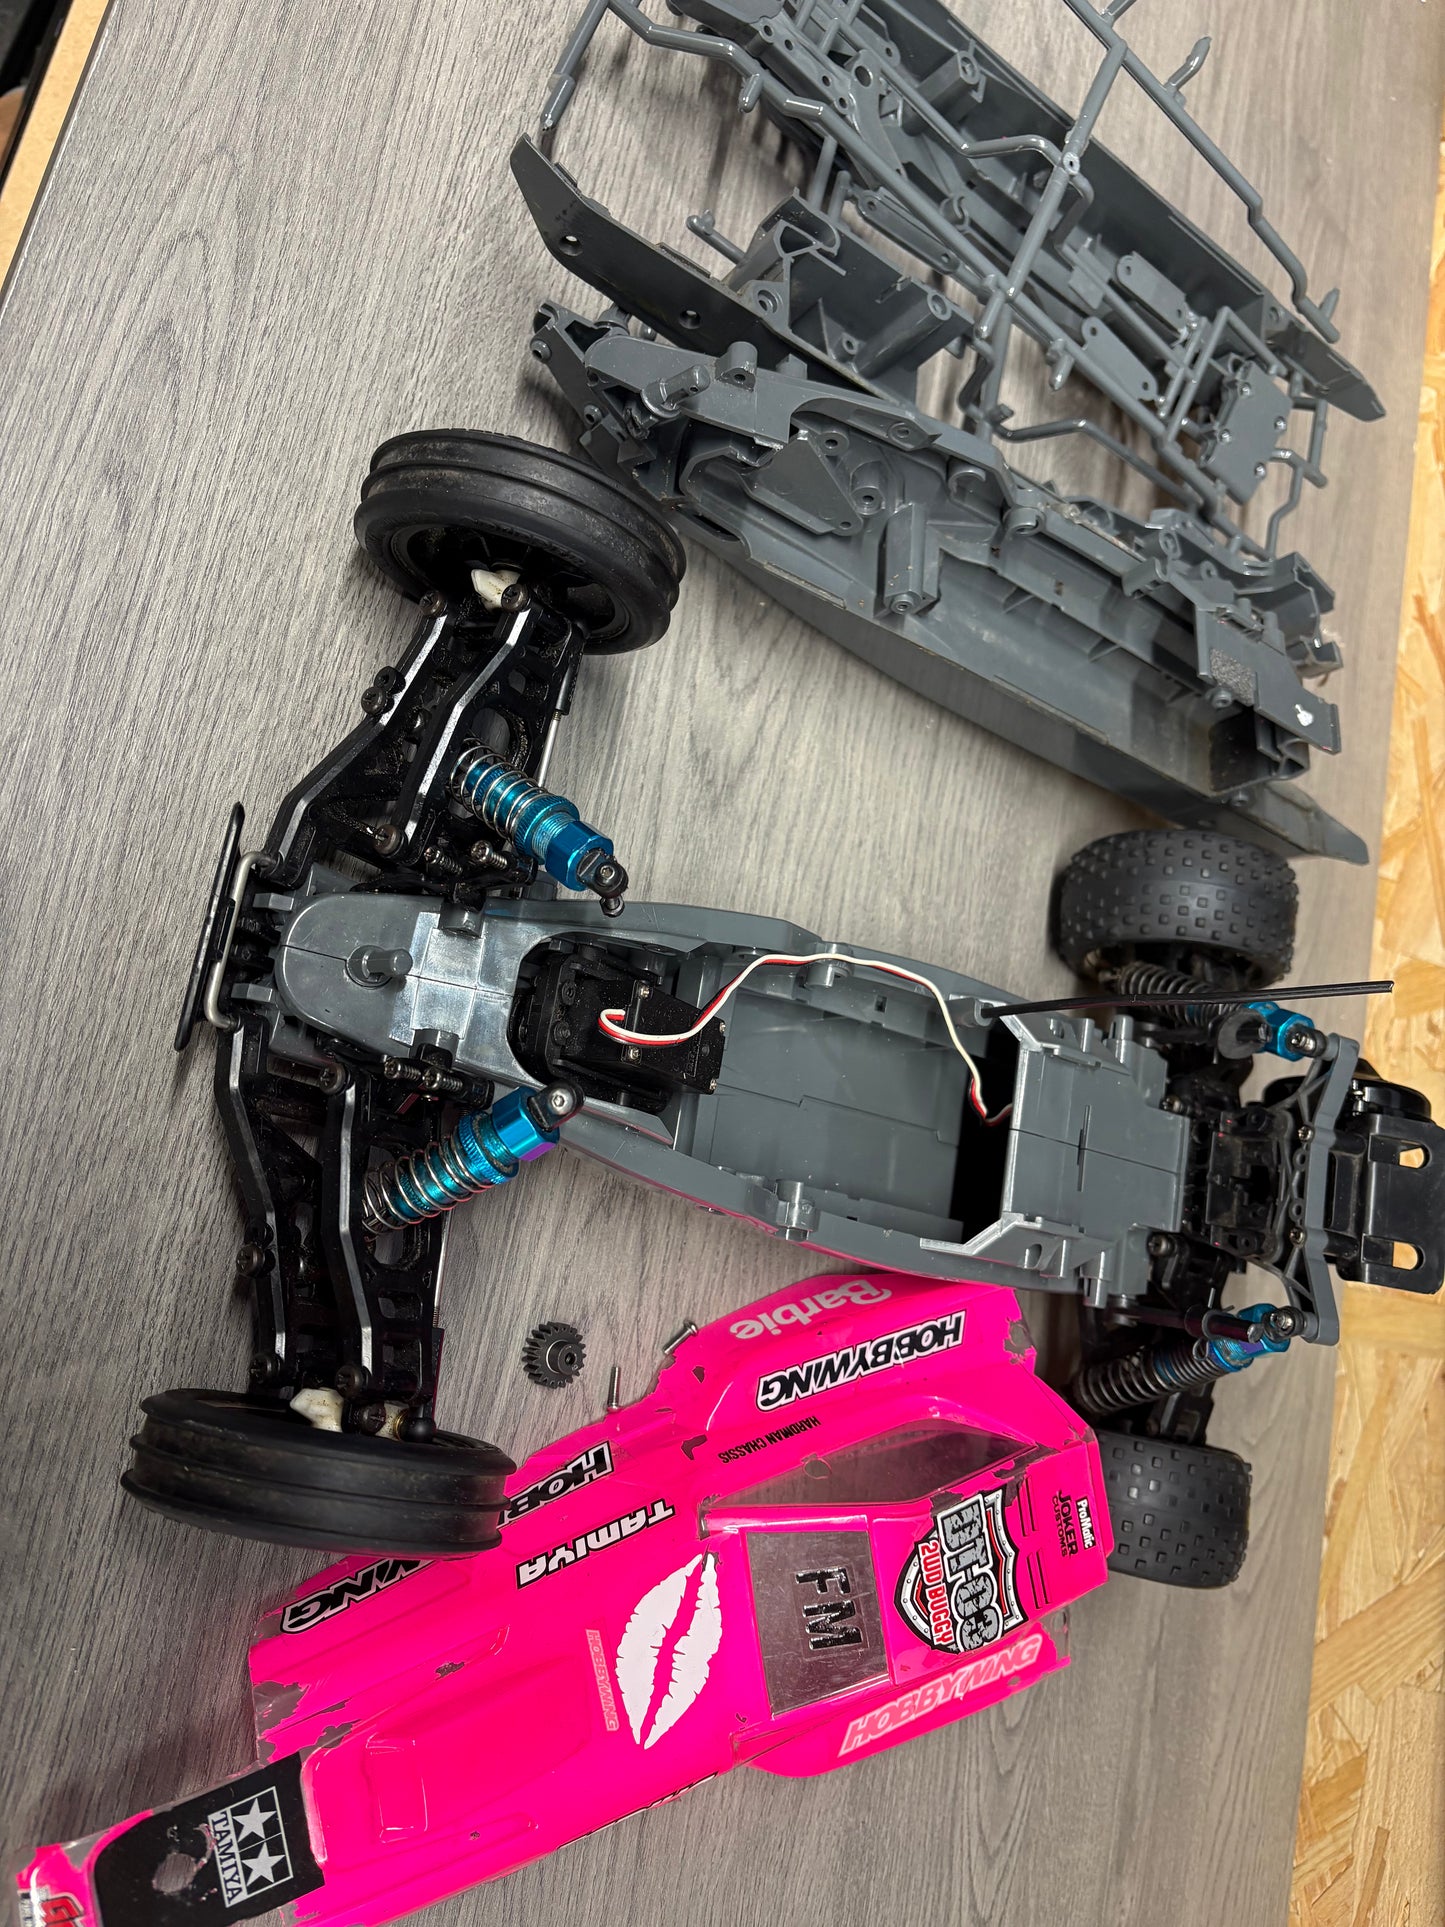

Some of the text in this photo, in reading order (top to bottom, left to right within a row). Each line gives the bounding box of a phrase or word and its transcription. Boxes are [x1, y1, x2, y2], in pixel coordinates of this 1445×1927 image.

[729, 1279, 893, 1340] Barbie
[757, 1310, 967, 1411] HOBBYWING
[717, 1415, 822, 1464] HARDMAN CHASSIS
[517, 1499, 676, 1590] TAMIYA
[1052, 1495, 1068, 1557] CUSTOMS
[1058, 1489, 1079, 1558] JOKER
[1076, 1497, 1096, 1550] ProMatic
[918, 1539, 954, 1645] 2WD BUGGY
[937, 1494, 1003, 1652] DT-03
[585, 1629, 620, 1731] HOBBYWING
[837, 1633, 1043, 1758] HOBBYWING
[210, 1810, 242, 1903] TAMIYA
